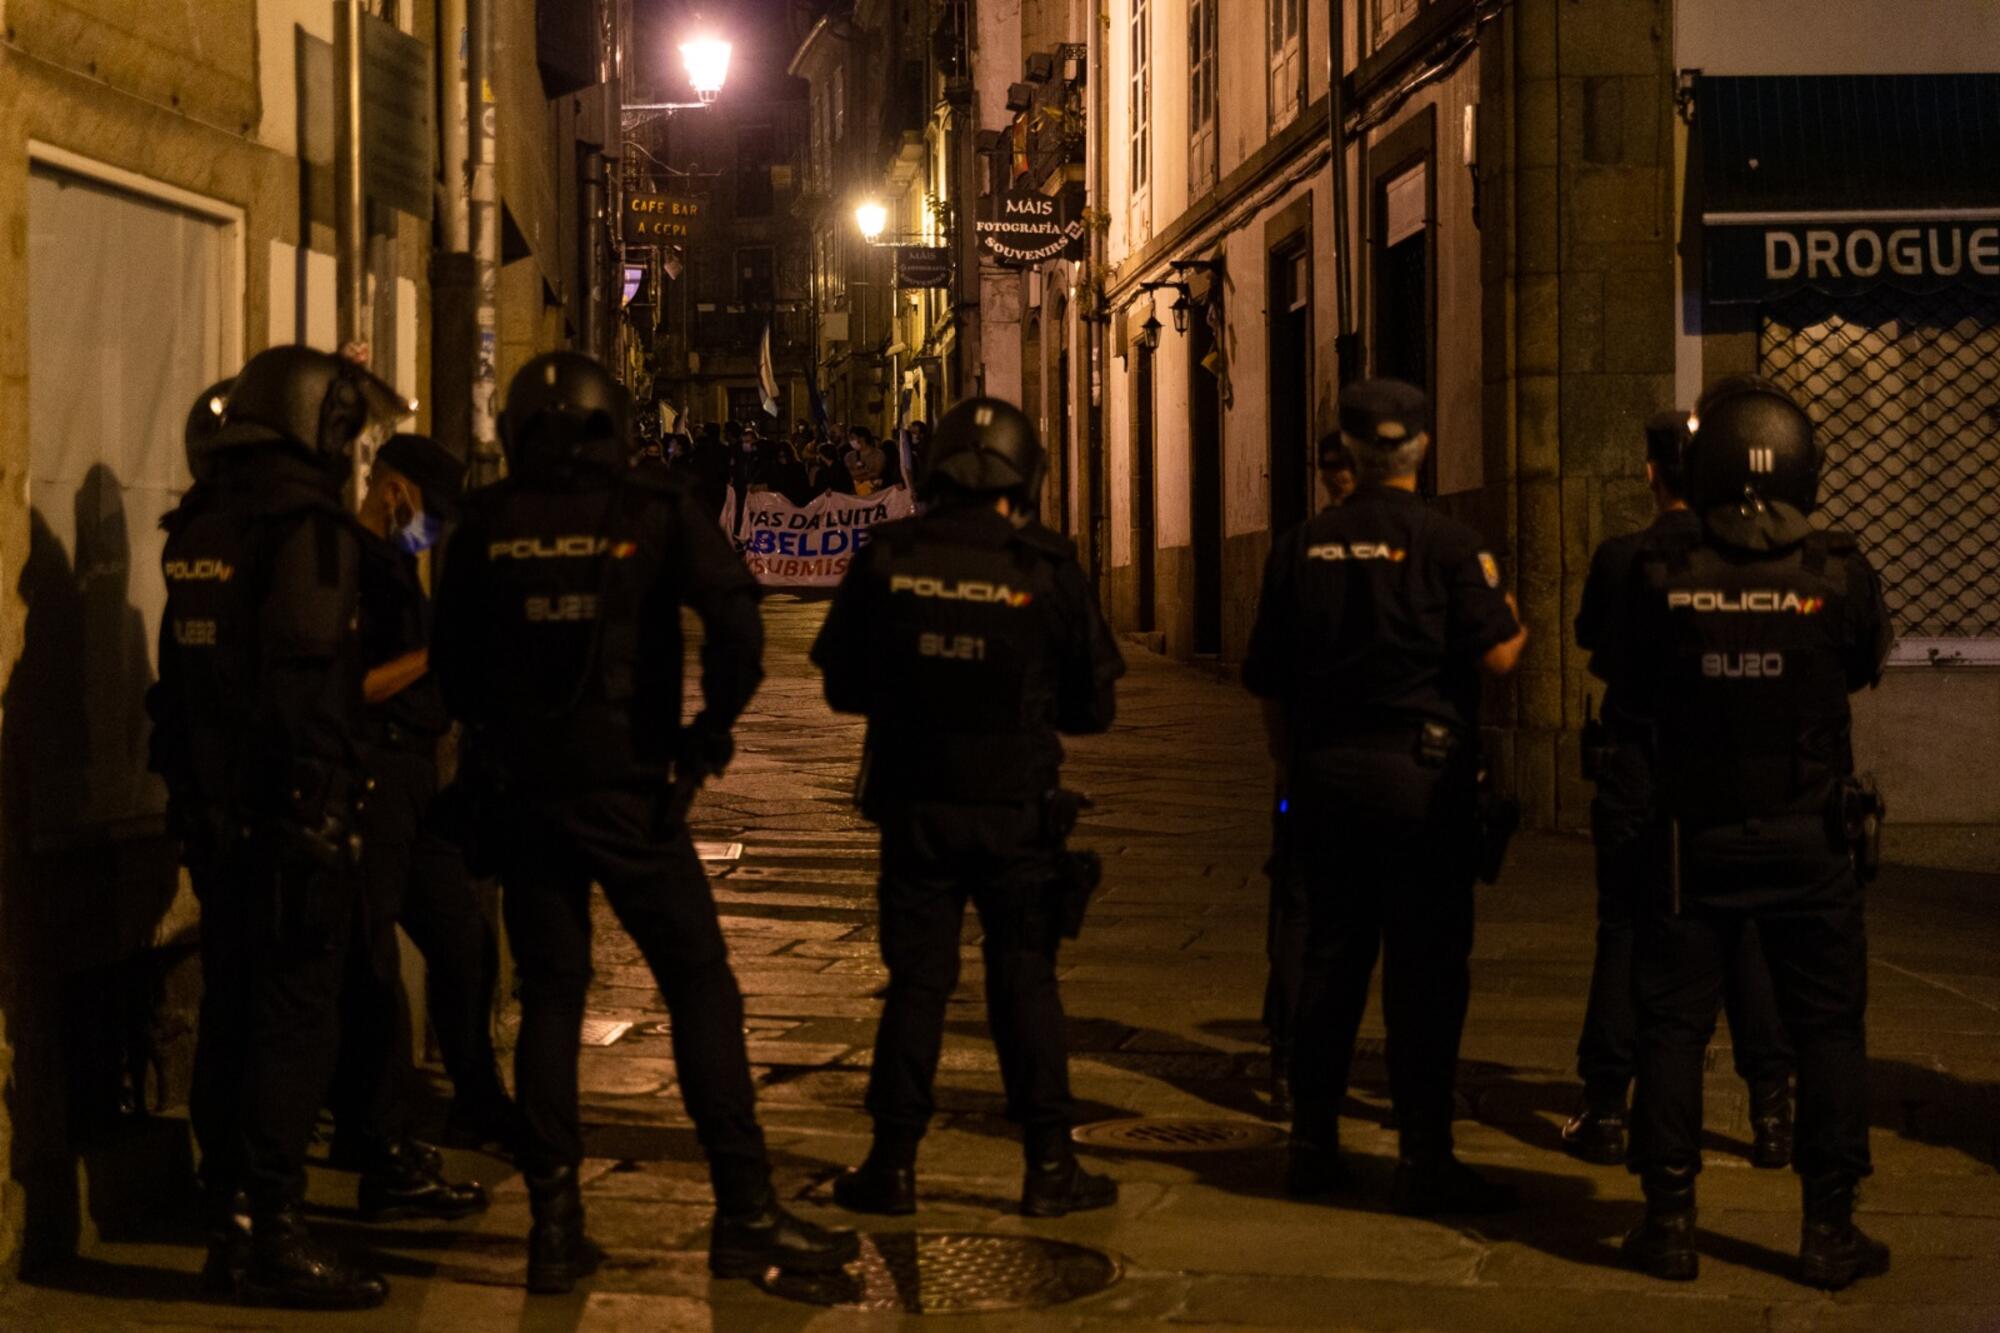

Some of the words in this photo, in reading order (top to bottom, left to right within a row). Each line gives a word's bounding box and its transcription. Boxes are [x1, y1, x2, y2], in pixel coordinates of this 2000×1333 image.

[631, 199, 666, 213] CAFE
[672, 203, 698, 217] BAR
[638, 221, 647, 235] A
[654, 223, 688, 237] CEPA
[984, 235, 1069, 260] SOUVENIRS
[1764, 227, 2000, 279] DROGUE
[788, 512, 820, 530] DA
[826, 504, 889, 528] LUITA
[1306, 542, 1391, 561] POLICIA
[165, 559, 223, 580] POLICIA
[889, 575, 1011, 605] POLICIA
[1667, 591, 1802, 612] POLICIA
